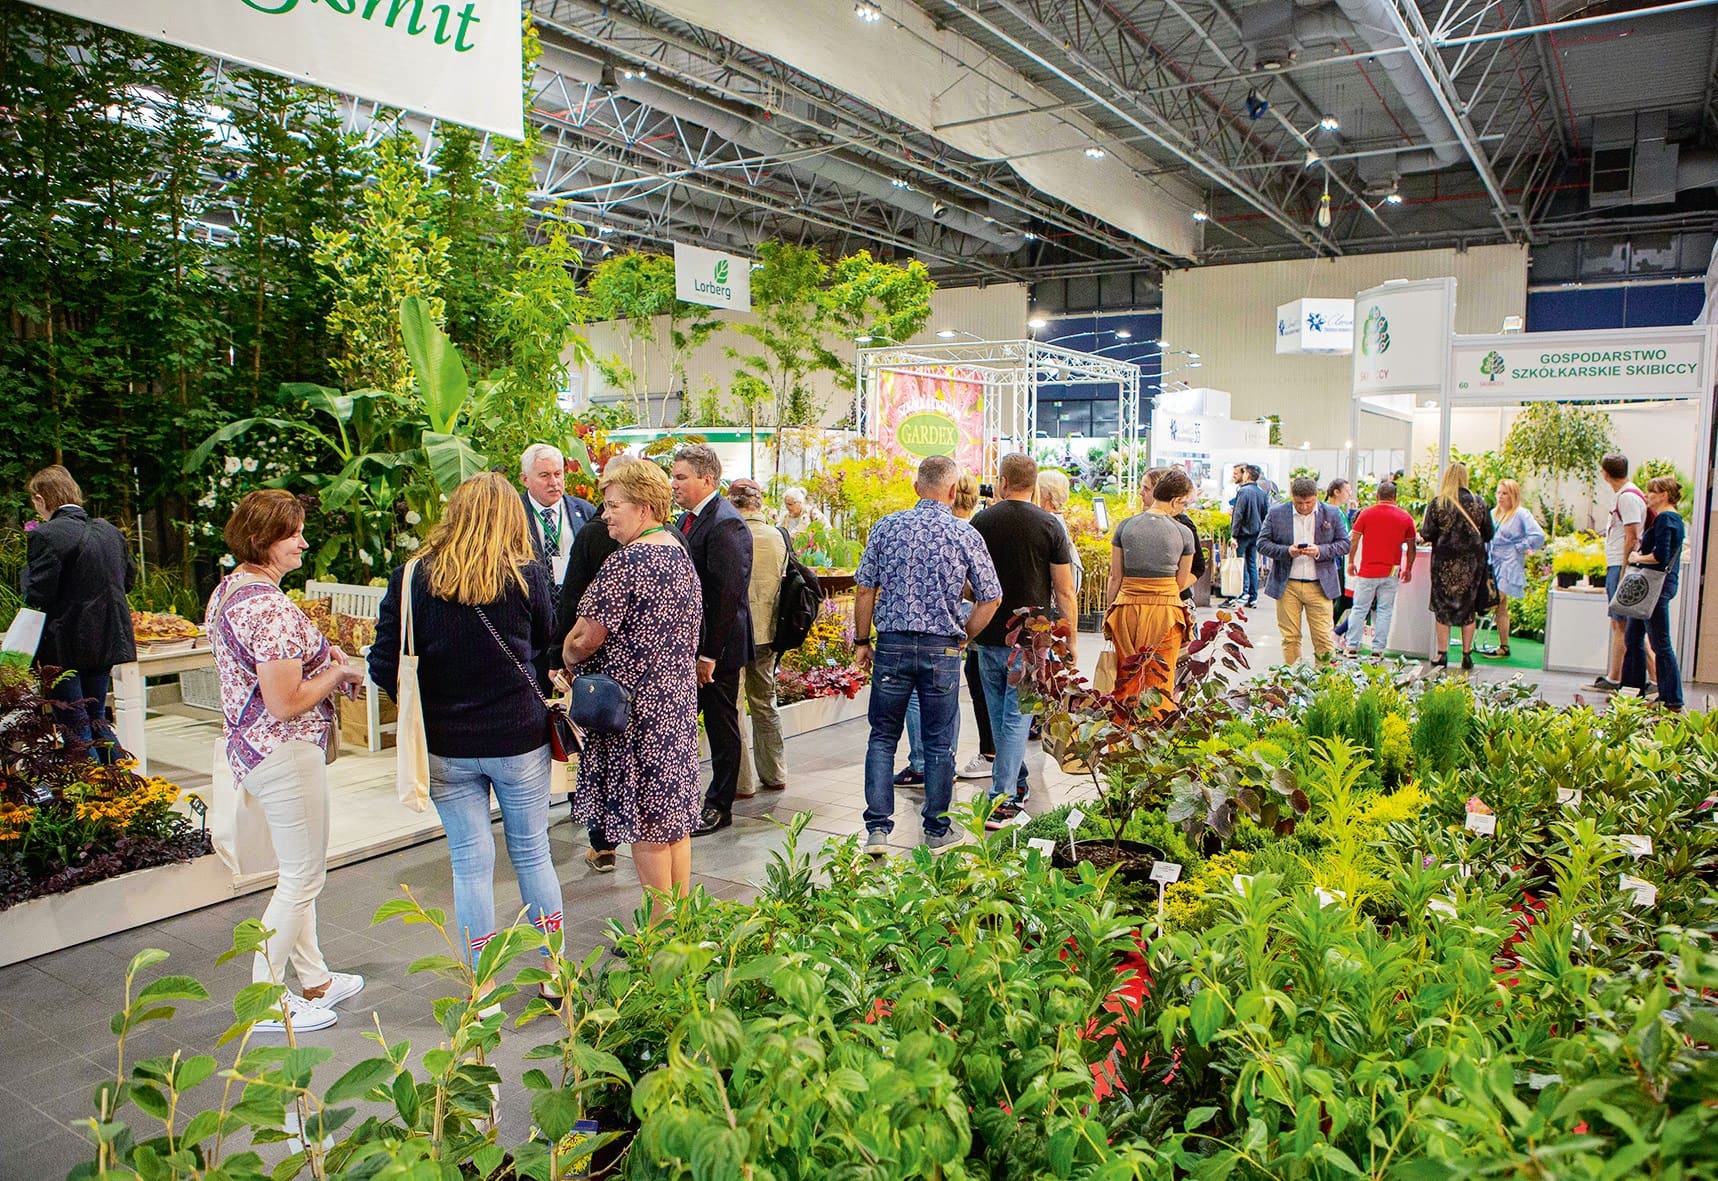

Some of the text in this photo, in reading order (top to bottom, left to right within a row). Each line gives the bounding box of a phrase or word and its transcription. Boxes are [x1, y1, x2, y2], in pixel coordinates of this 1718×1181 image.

[694, 278, 731, 300] Lorberg
[1540, 349, 1667, 364] GOSPODARSTWO
[1511, 363, 1698, 379] SZKÓŁKARSKIE SKIBICCY
[1458, 381, 1469, 389] 60
[901, 424, 955, 445] GARDEX
